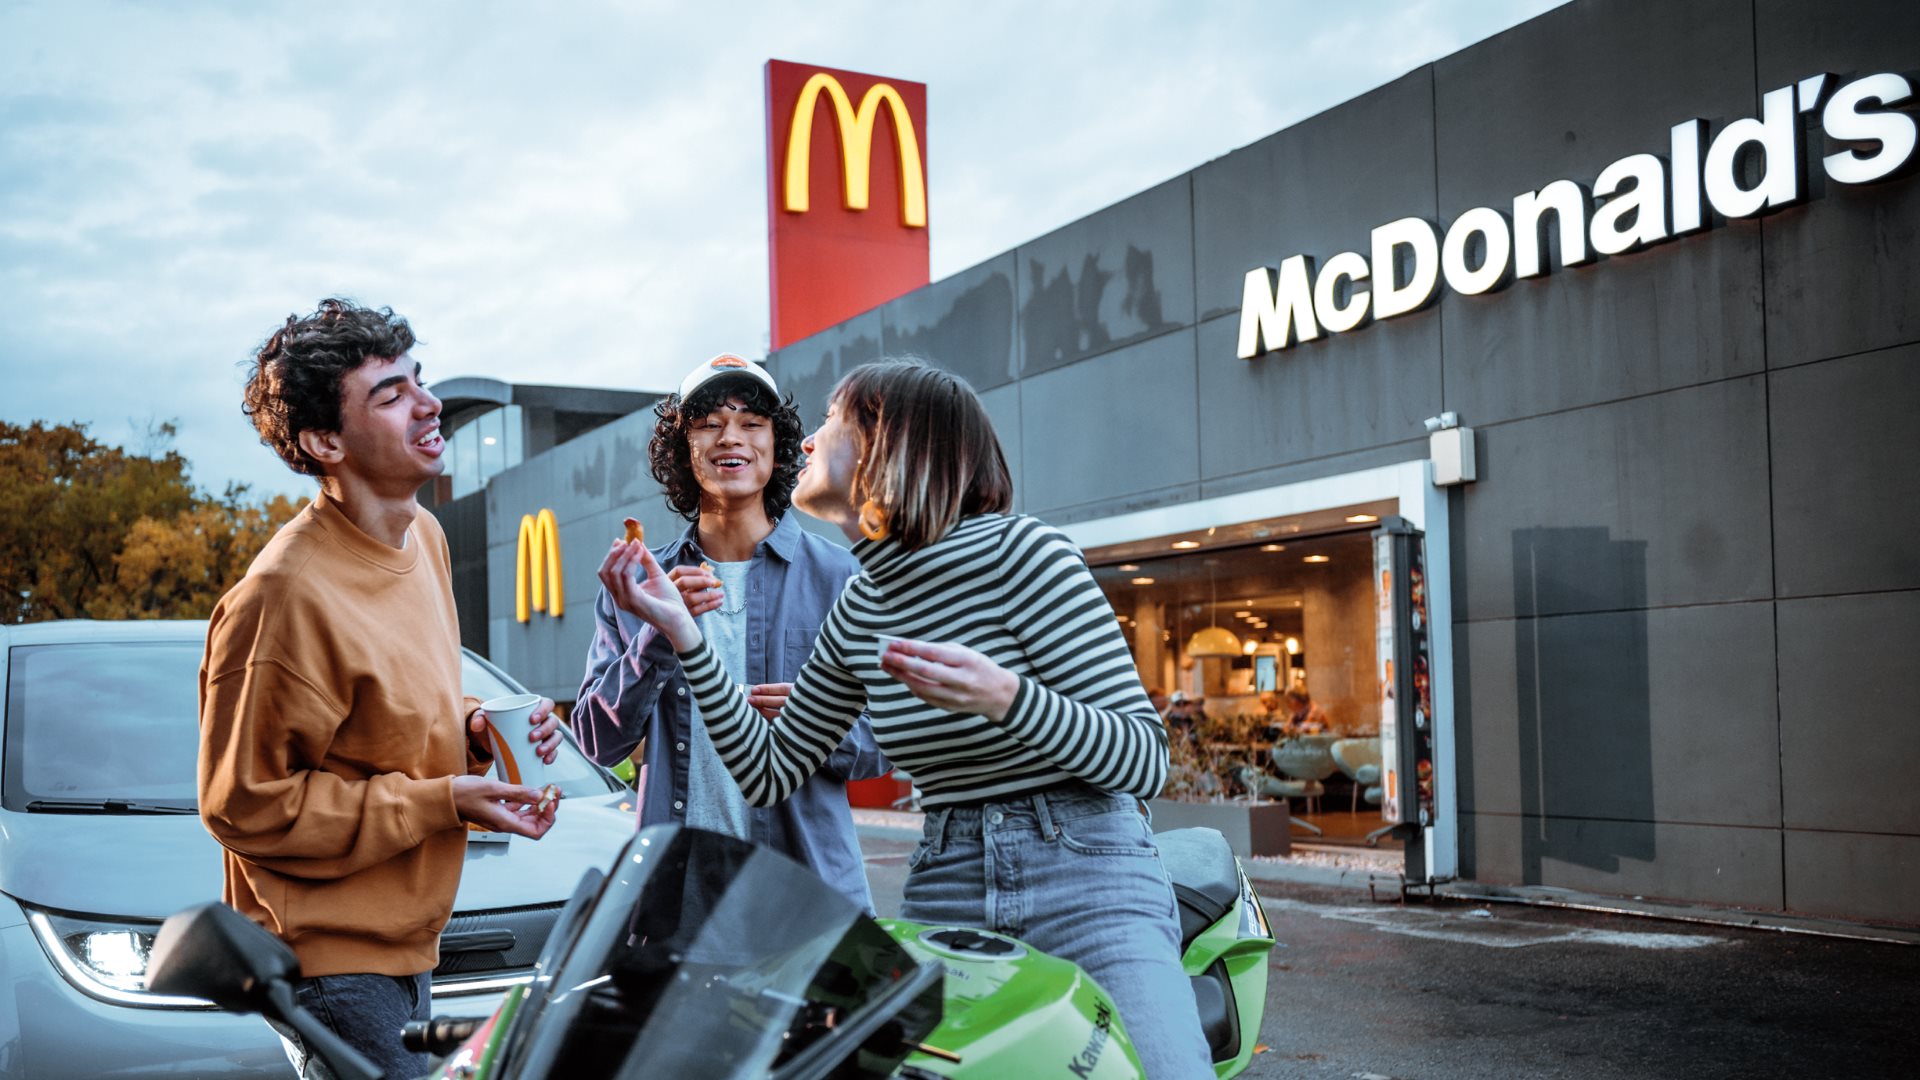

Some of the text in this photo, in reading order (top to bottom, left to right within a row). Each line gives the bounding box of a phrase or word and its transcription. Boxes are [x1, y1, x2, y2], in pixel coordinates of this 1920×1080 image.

[784, 72, 926, 228] M
[1236, 72, 1918, 359] McDonald's
[516, 507, 564, 623] M
